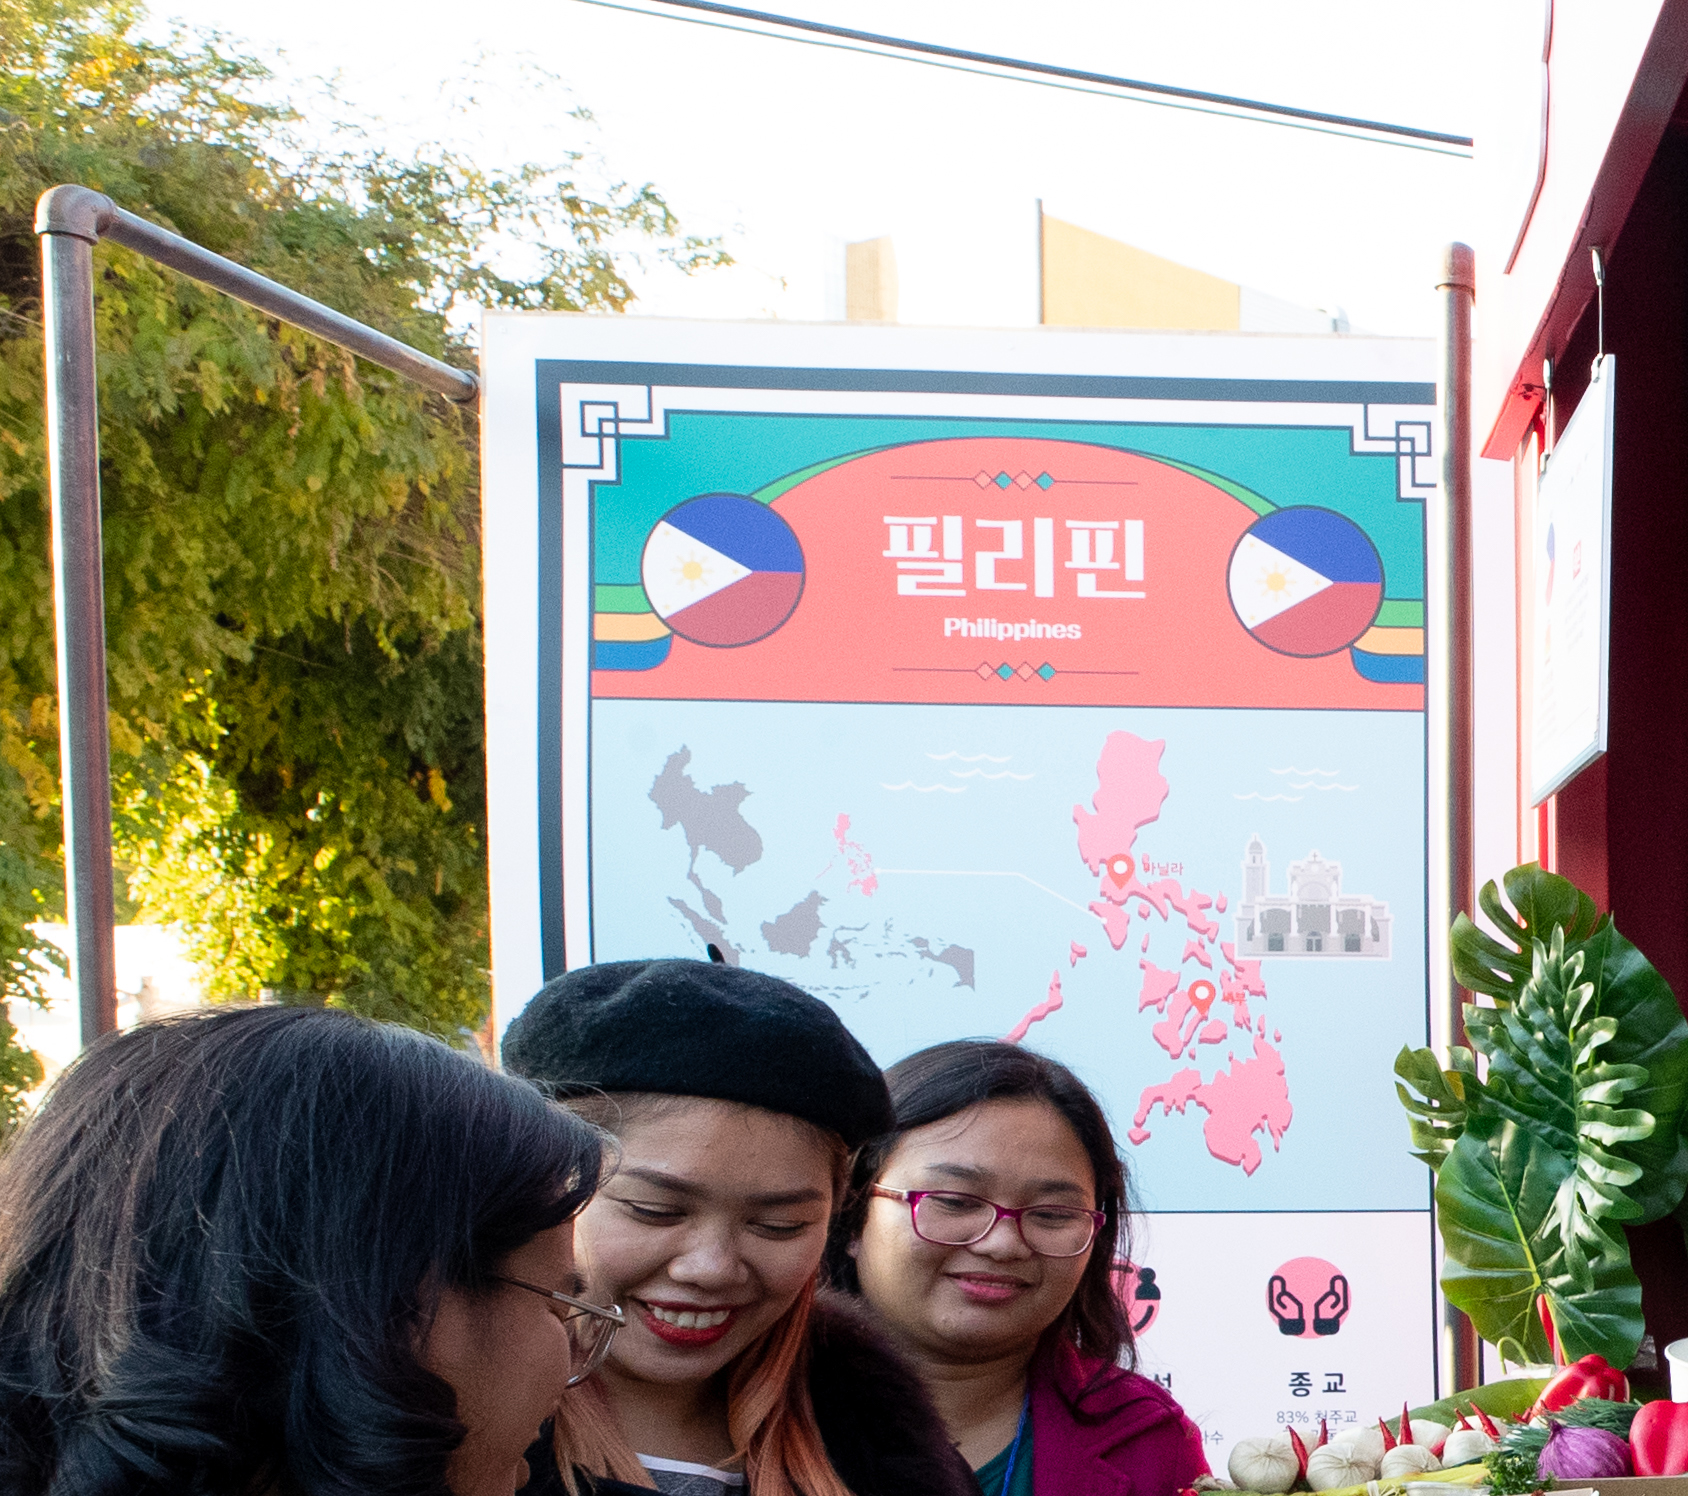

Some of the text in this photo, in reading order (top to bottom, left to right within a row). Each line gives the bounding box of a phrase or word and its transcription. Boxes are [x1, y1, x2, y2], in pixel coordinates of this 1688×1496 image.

[882, 515, 1146, 598] 필리핀
[944, 617, 1082, 641] Philippines
[1276, 1410, 1358, 1426] 83% 천주교
